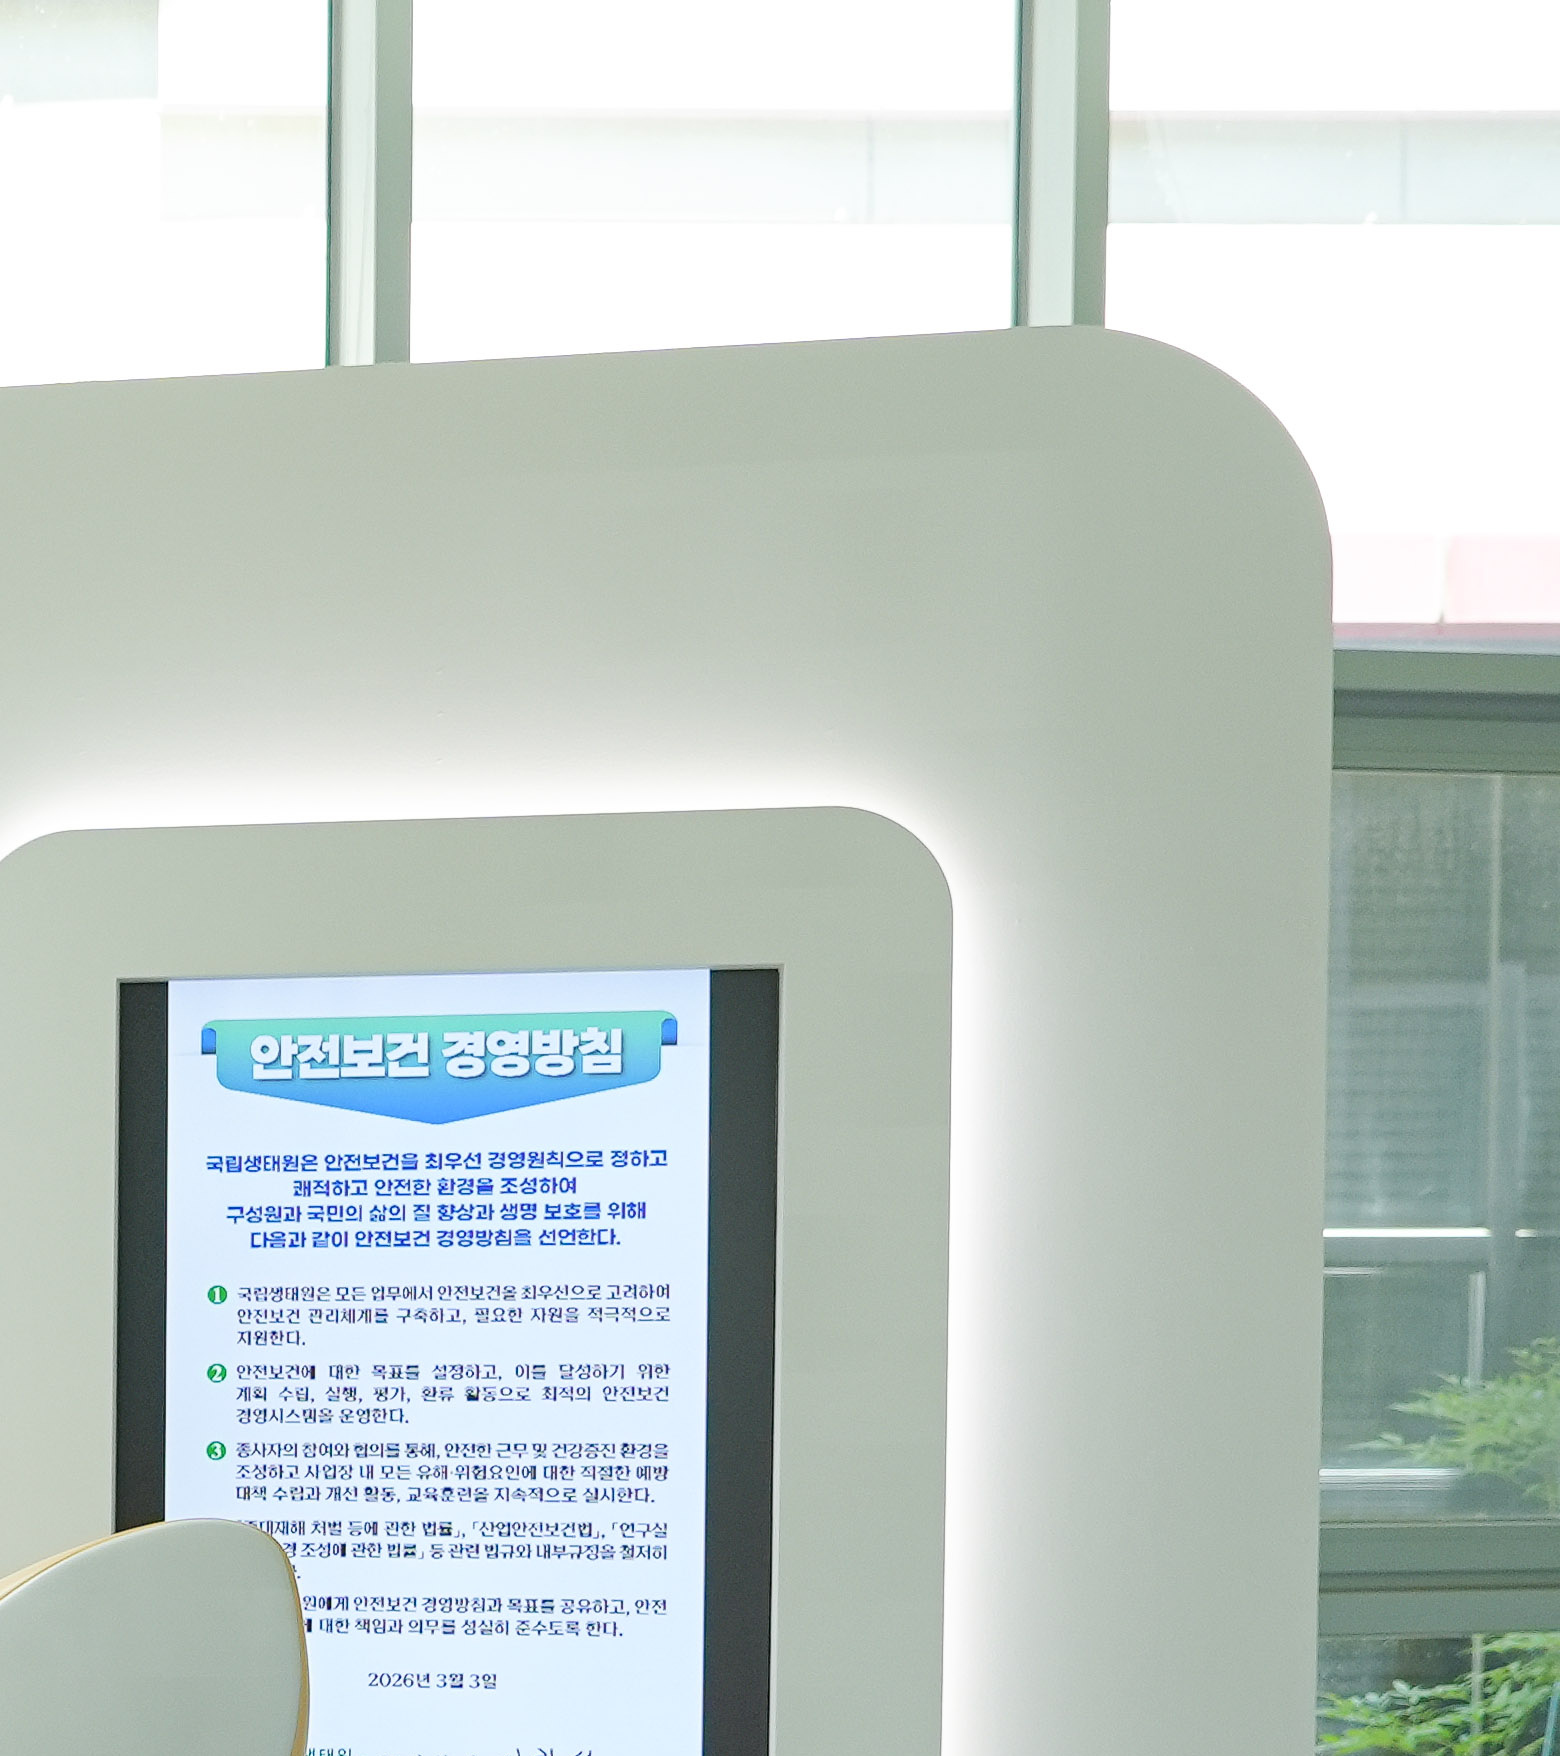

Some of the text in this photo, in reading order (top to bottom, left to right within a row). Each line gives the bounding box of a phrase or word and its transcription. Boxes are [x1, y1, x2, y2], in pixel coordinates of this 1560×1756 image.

[250, 1027, 625, 1082] 안전보건 경영방침
[206, 1149, 668, 1173] 국립생태원은 안전보건을 최우선 경영원칙으로 정하고
[293, 1177, 576, 1197] 쾌적하고 안전한 환경을 조성하여
[226, 1201, 646, 1224] 구성원과 국민의 삶의 질 향상과 생명 보호를 위해
[250, 1228, 621, 1249] 다음과 같이 안전보건 경영방침을 선언한다.
[237, 1286, 331, 1303] 국립생태원은
[335, 1287, 366, 1301] 모든
[371, 1285, 432, 1302] 업무에서
[437, 1285, 517, 1301] 안전보건을
[521, 1284, 602, 1300] 최우선으로
[606, 1283, 669, 1300] 고려하여
[237, 1307, 670, 1325] 안전보건 관리체계를 구축하고, 필요한 자원을 적극적으로
[237, 1330, 305, 1346] 지원한다.
[237, 1364, 316, 1380] 안전보건에
[329, 1364, 360, 1380] 대한
[371, 1365, 420, 1380] 목표를
[432, 1364, 502, 1381] 설정하고,
[515, 1364, 546, 1380] 이를
[559, 1364, 624, 1380] 달성하기
[638, 1363, 670, 1380] 위한
[236, 1442, 297, 1458] 종사자의
[302, 1443, 350, 1458] 참여와
[353, 1443, 400, 1458] 협의를
[404, 1443, 440, 1460] 통해,
[445, 1443, 492, 1458] 안전한
[496, 1443, 528, 1459] 근무
[532, 1443, 547, 1459] 및
[552, 1443, 616, 1459] 건강증진
[620, 1442, 669, 1459] 환경을
[354, 1596, 417, 1612] 안전보건
[421, 1597, 502, 1613] 경영방침과
[507, 1598, 555, 1614] 목표를
[560, 1598, 630, 1616] 공유하고,
[635, 1599, 666, 1615] 안전
[320, 1618, 623, 1637] 대한 책임과 의무를 성실히 준수도록 한다.
[368, 1673, 496, 1689] 2026년 3월 3일
